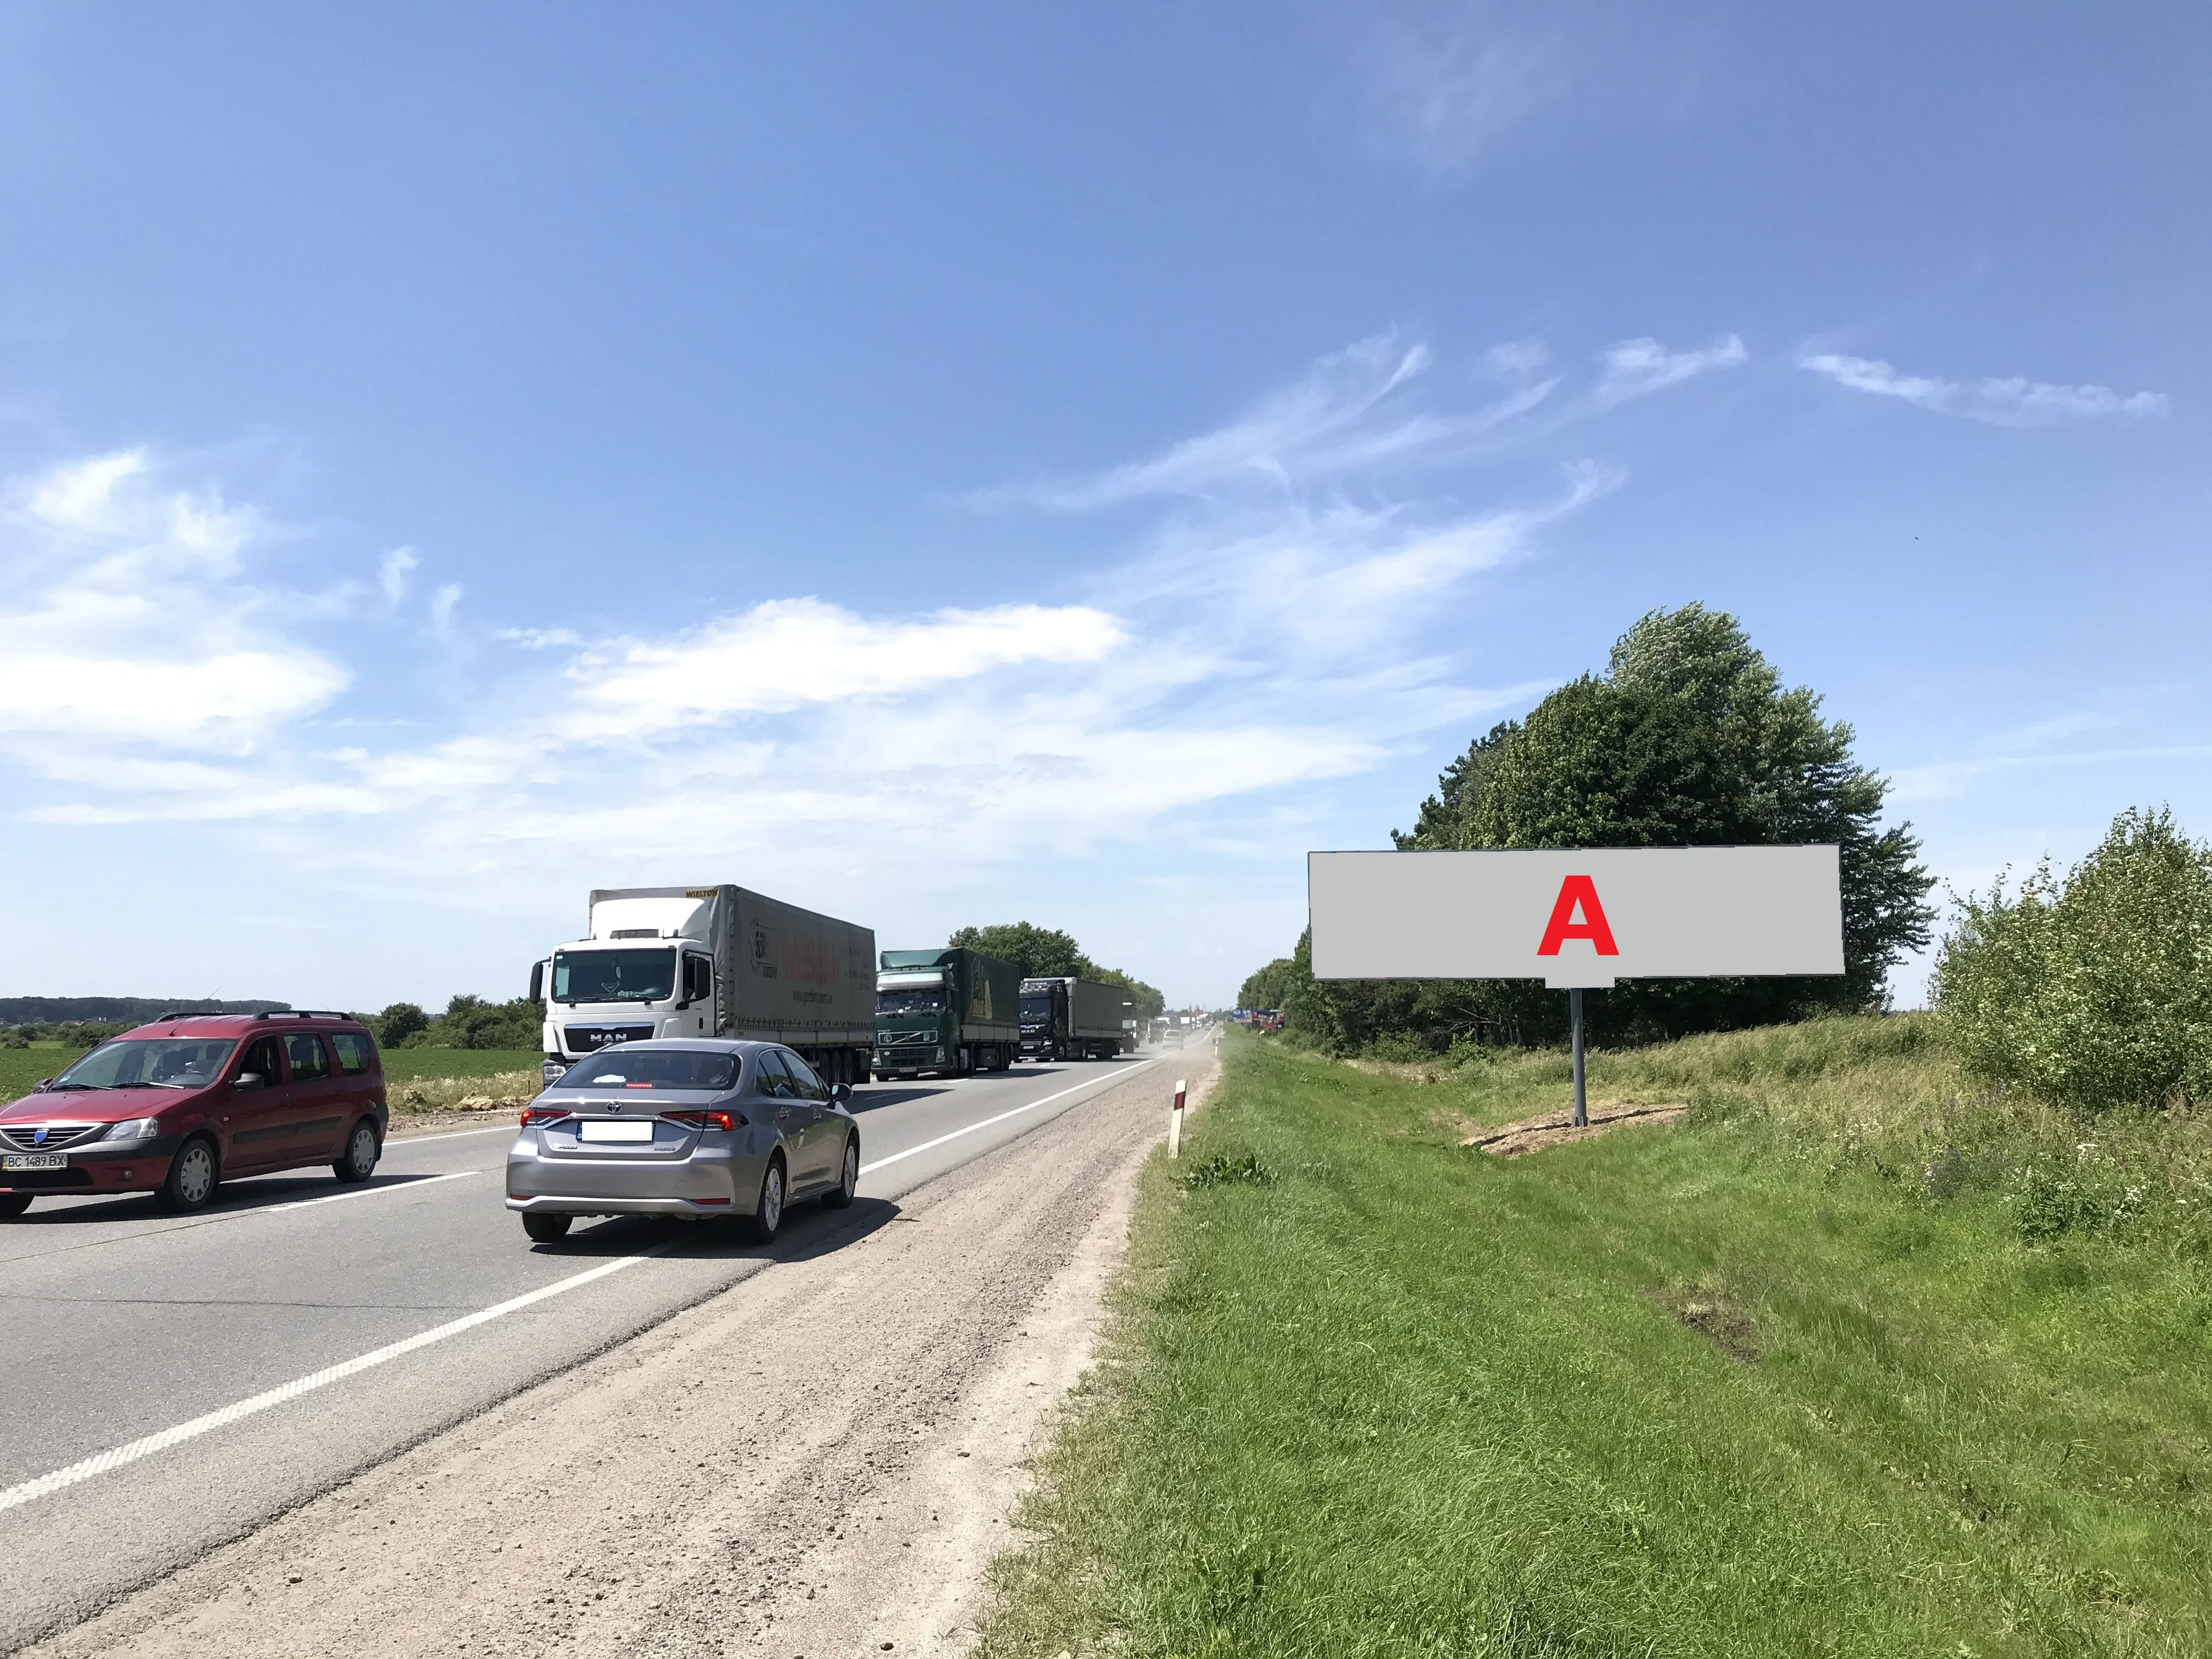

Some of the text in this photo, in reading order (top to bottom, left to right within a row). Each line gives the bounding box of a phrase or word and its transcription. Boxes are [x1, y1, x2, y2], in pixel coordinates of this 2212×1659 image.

[685, 889, 718, 898] WIELTON
[590, 1033, 627, 1042] MAN
[8, 1155, 65, 1167] BC 1489 BX
